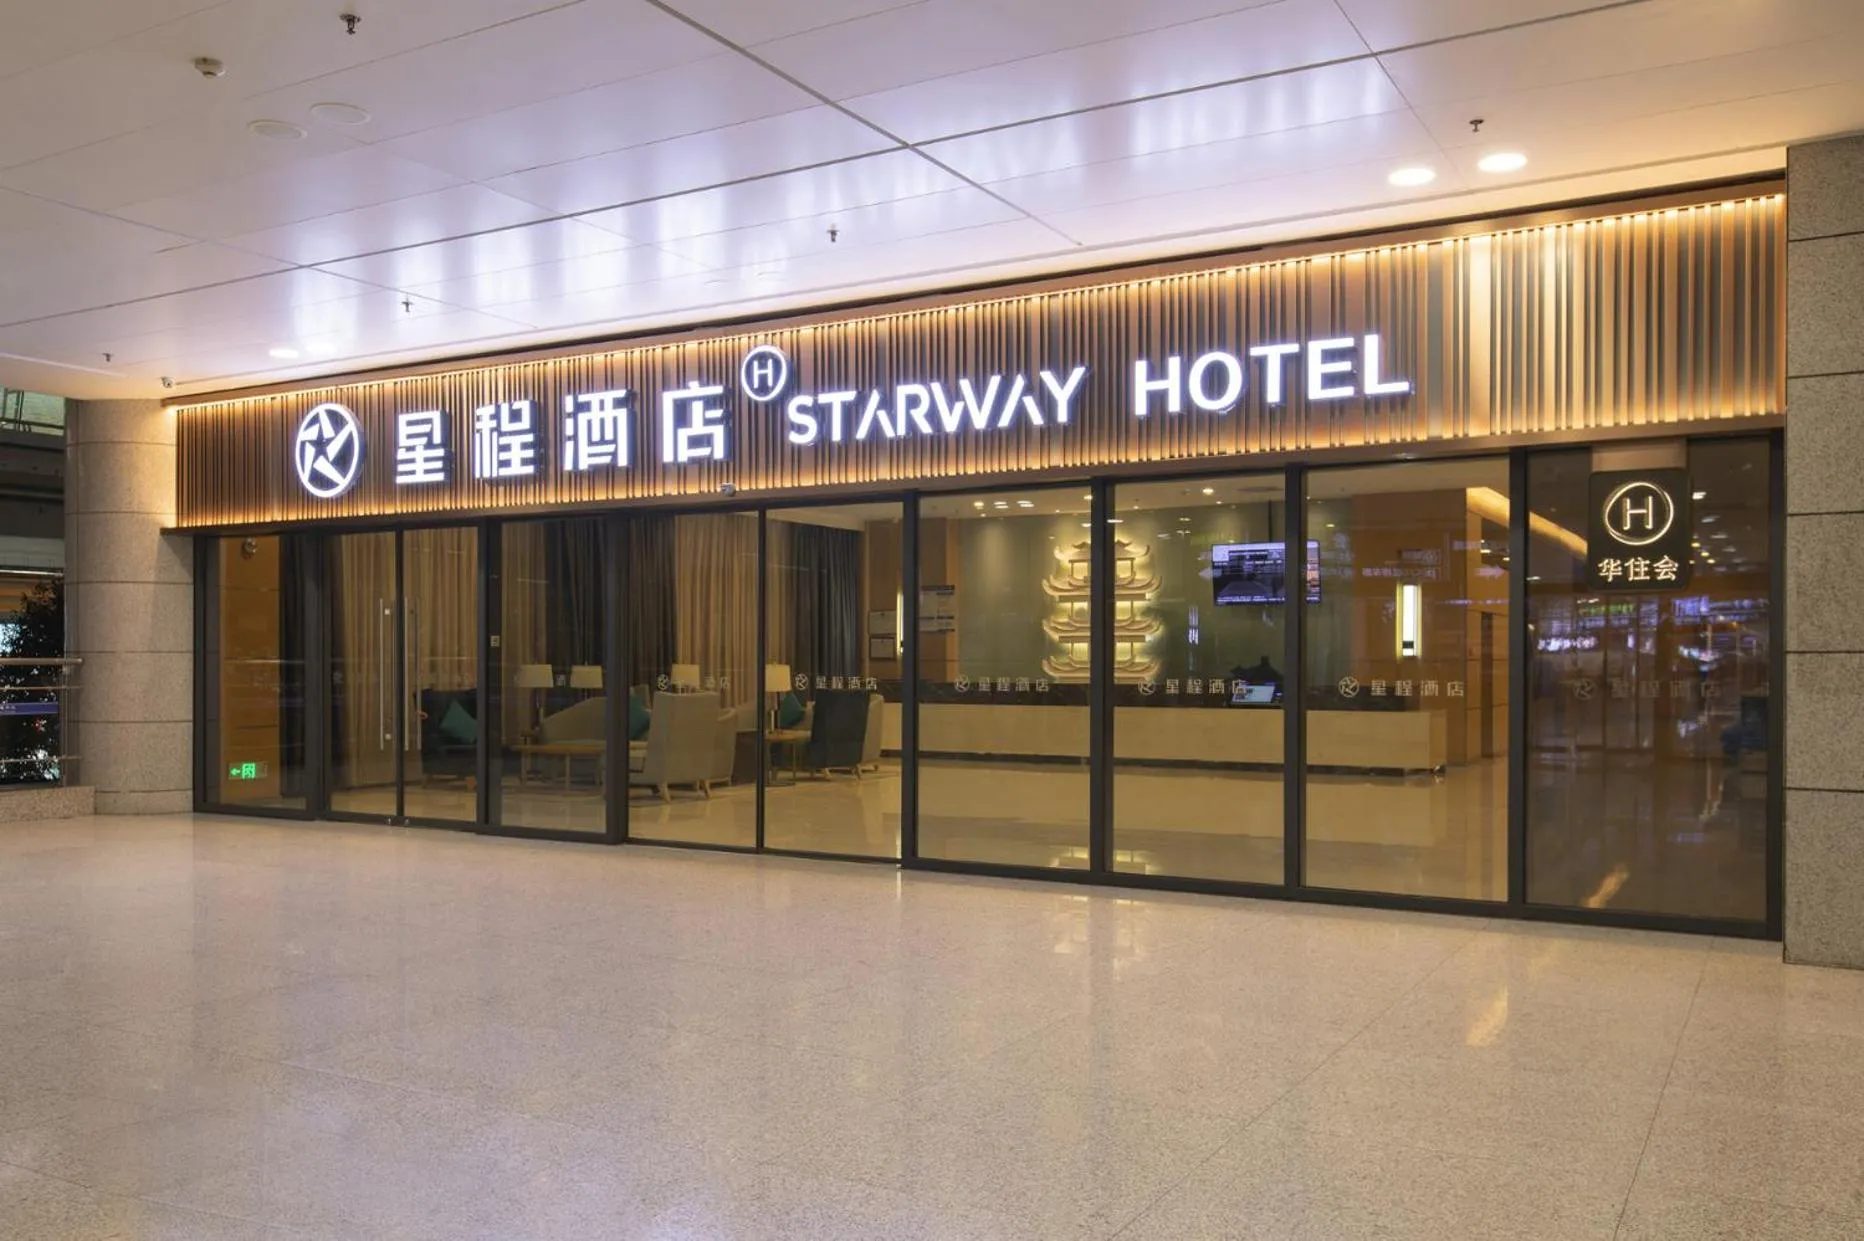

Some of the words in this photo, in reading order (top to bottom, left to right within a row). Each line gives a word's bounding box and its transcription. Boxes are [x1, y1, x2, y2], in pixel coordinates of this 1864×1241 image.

[788, 366, 1086, 445] STARWAY
[1135, 333, 1410, 416] HOTEL
[395, 381, 727, 484] 星程酒店
[1598, 555, 1679, 582] 华住会
[978, 677, 1050, 693] 星程酒店
[1166, 678, 1247, 695] 星程酒店
[1370, 679, 1465, 697] 星程酒店
